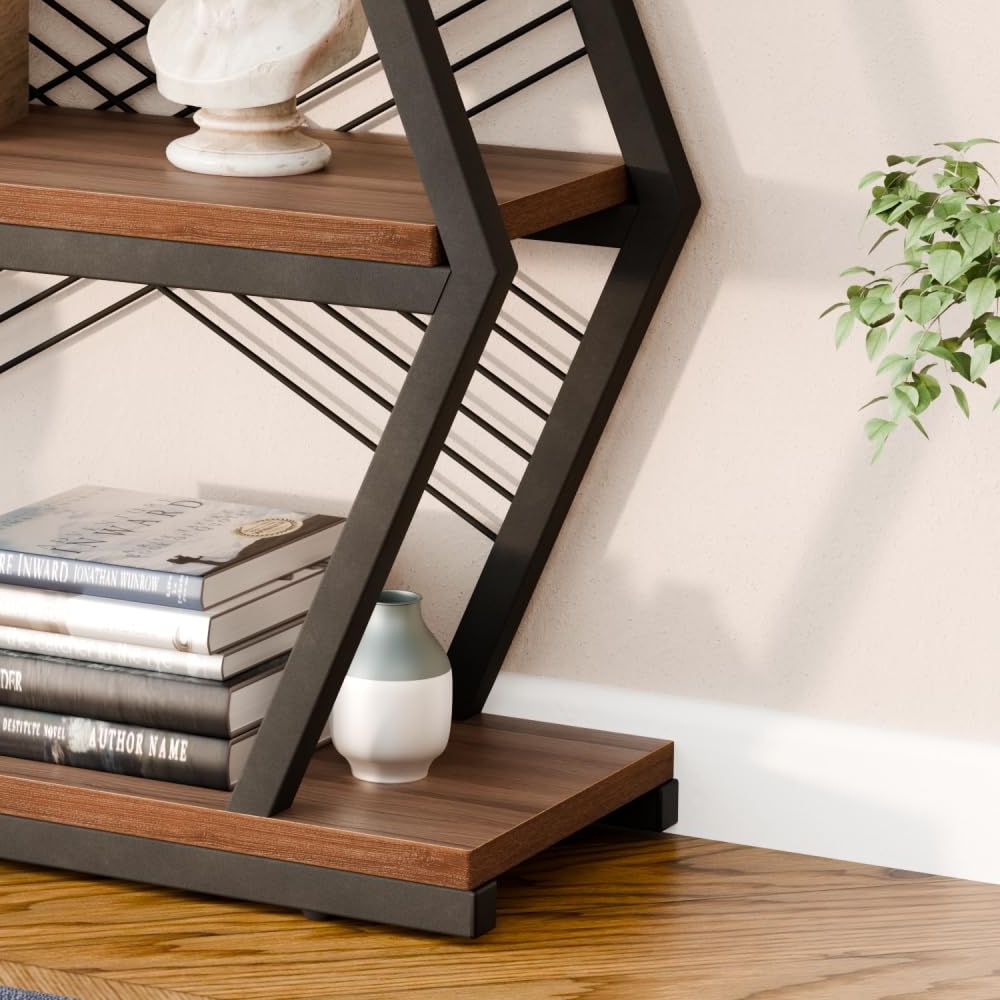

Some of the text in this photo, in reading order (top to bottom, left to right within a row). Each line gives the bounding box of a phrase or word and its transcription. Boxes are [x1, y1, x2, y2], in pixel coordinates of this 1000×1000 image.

[51, 499, 204, 554] INWARD
[17, 552, 69, 583] INWARD
[73, 563, 117, 587] JONATHAN
[44, 725, 66, 741] NOVEL
[88, 727, 188, 762] AUTHOR NAME
